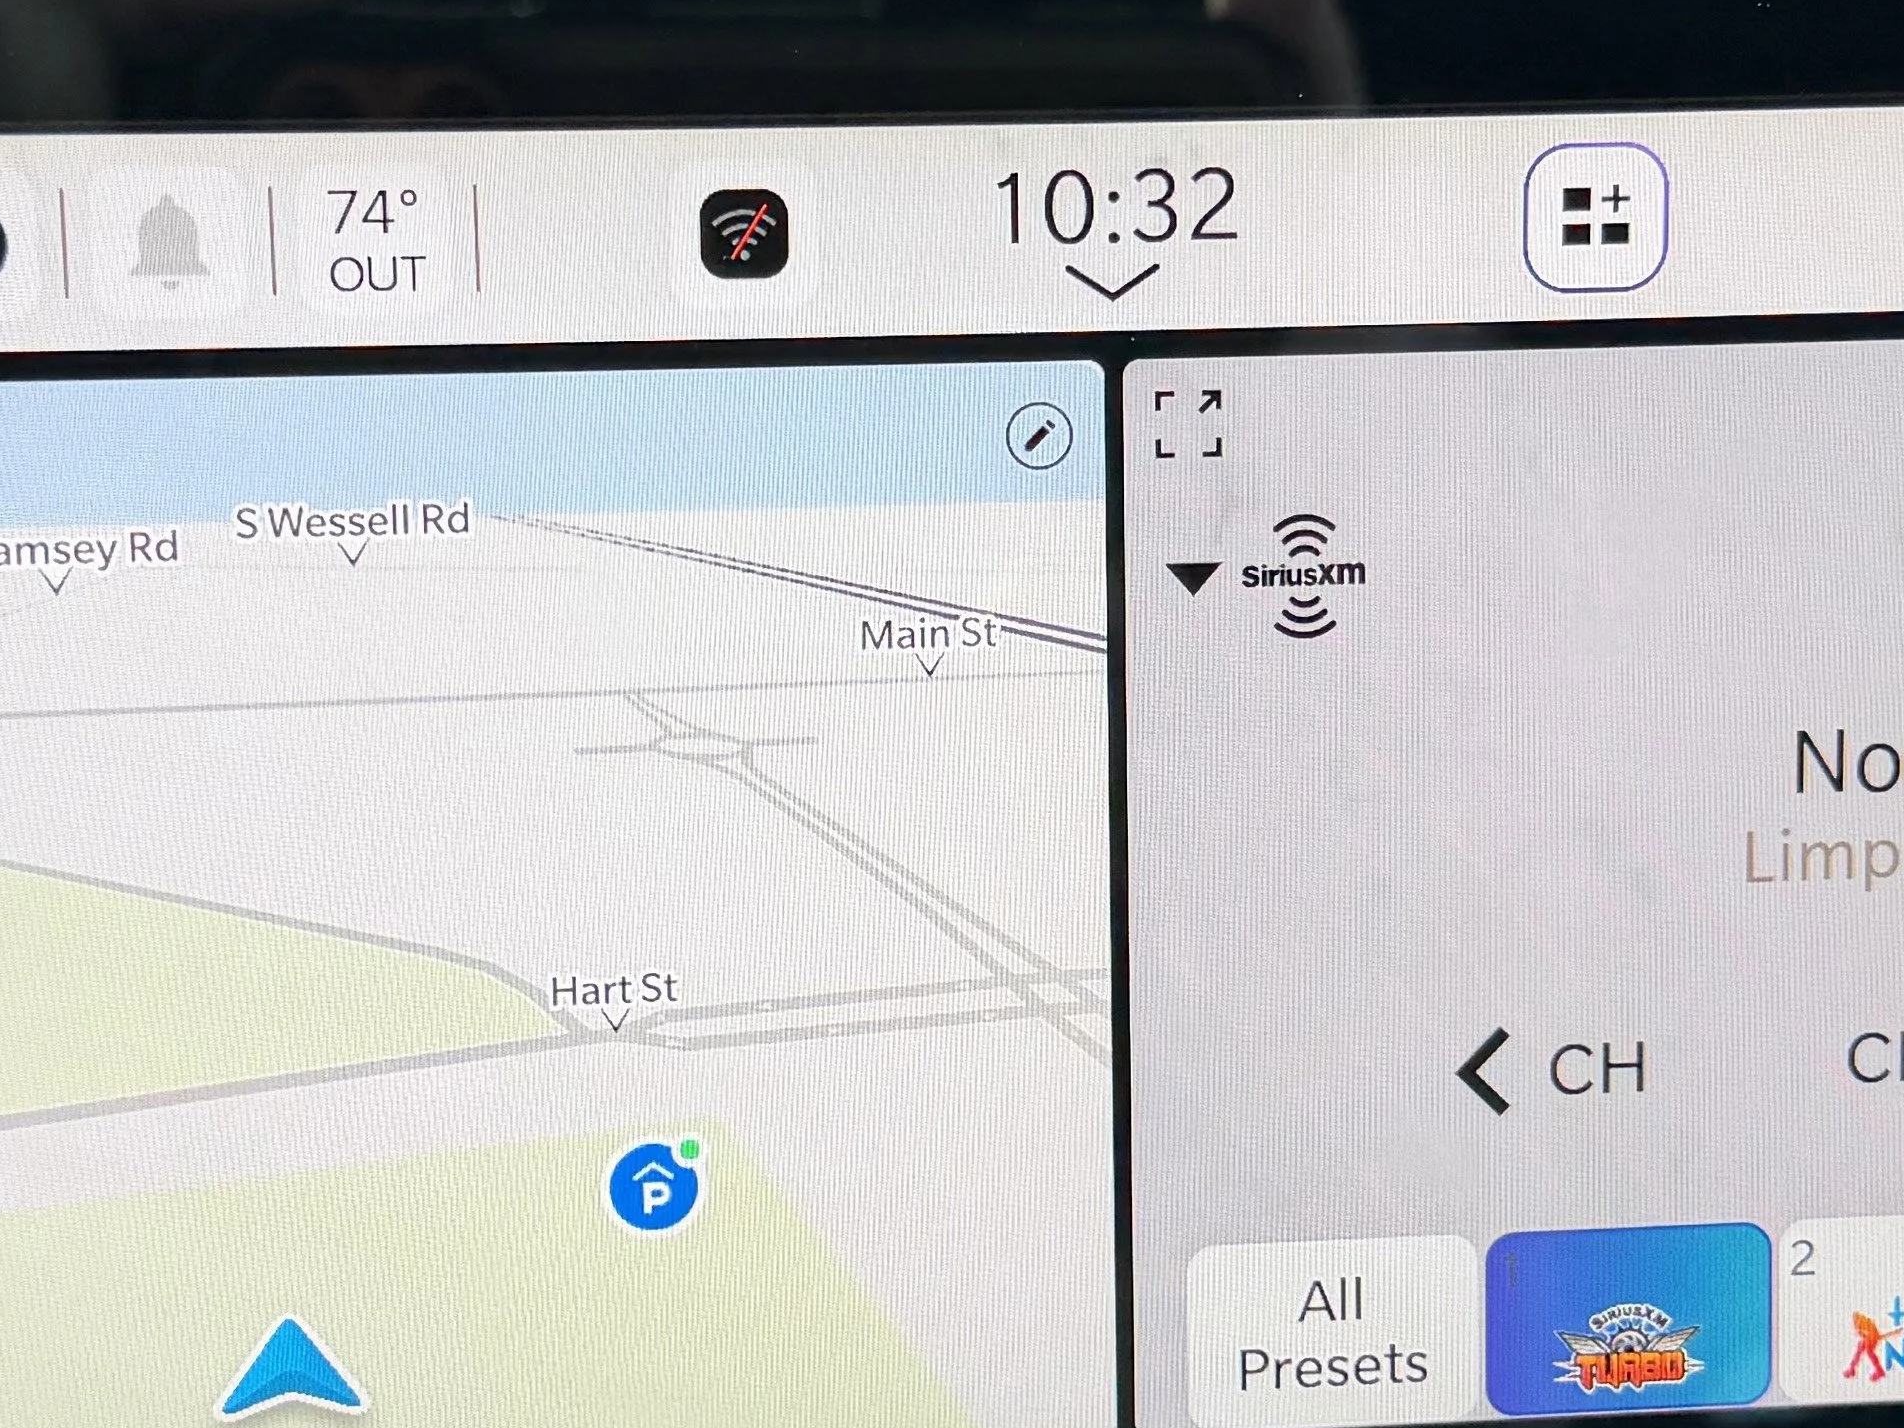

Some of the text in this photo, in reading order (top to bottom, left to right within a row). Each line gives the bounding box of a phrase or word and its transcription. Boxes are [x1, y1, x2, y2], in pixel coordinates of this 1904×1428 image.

[326, 188, 419, 235] 74°
[995, 164, 1239, 245] 10:32
[329, 254, 428, 293] OUT
[236, 501, 471, 540] S Wessell Rd
[130, 529, 179, 564] Rd
[861, 616, 998, 651] Main St
[1744, 827, 1902, 892] Limp
[550, 972, 679, 1008] Hart St
[1549, 1040, 1646, 1096] CH
[1790, 1239, 1816, 1277] 2
[1296, 1276, 1364, 1323] All
[1240, 1343, 1430, 1392] Presets
[1574, 1350, 1686, 1392] TURBO
